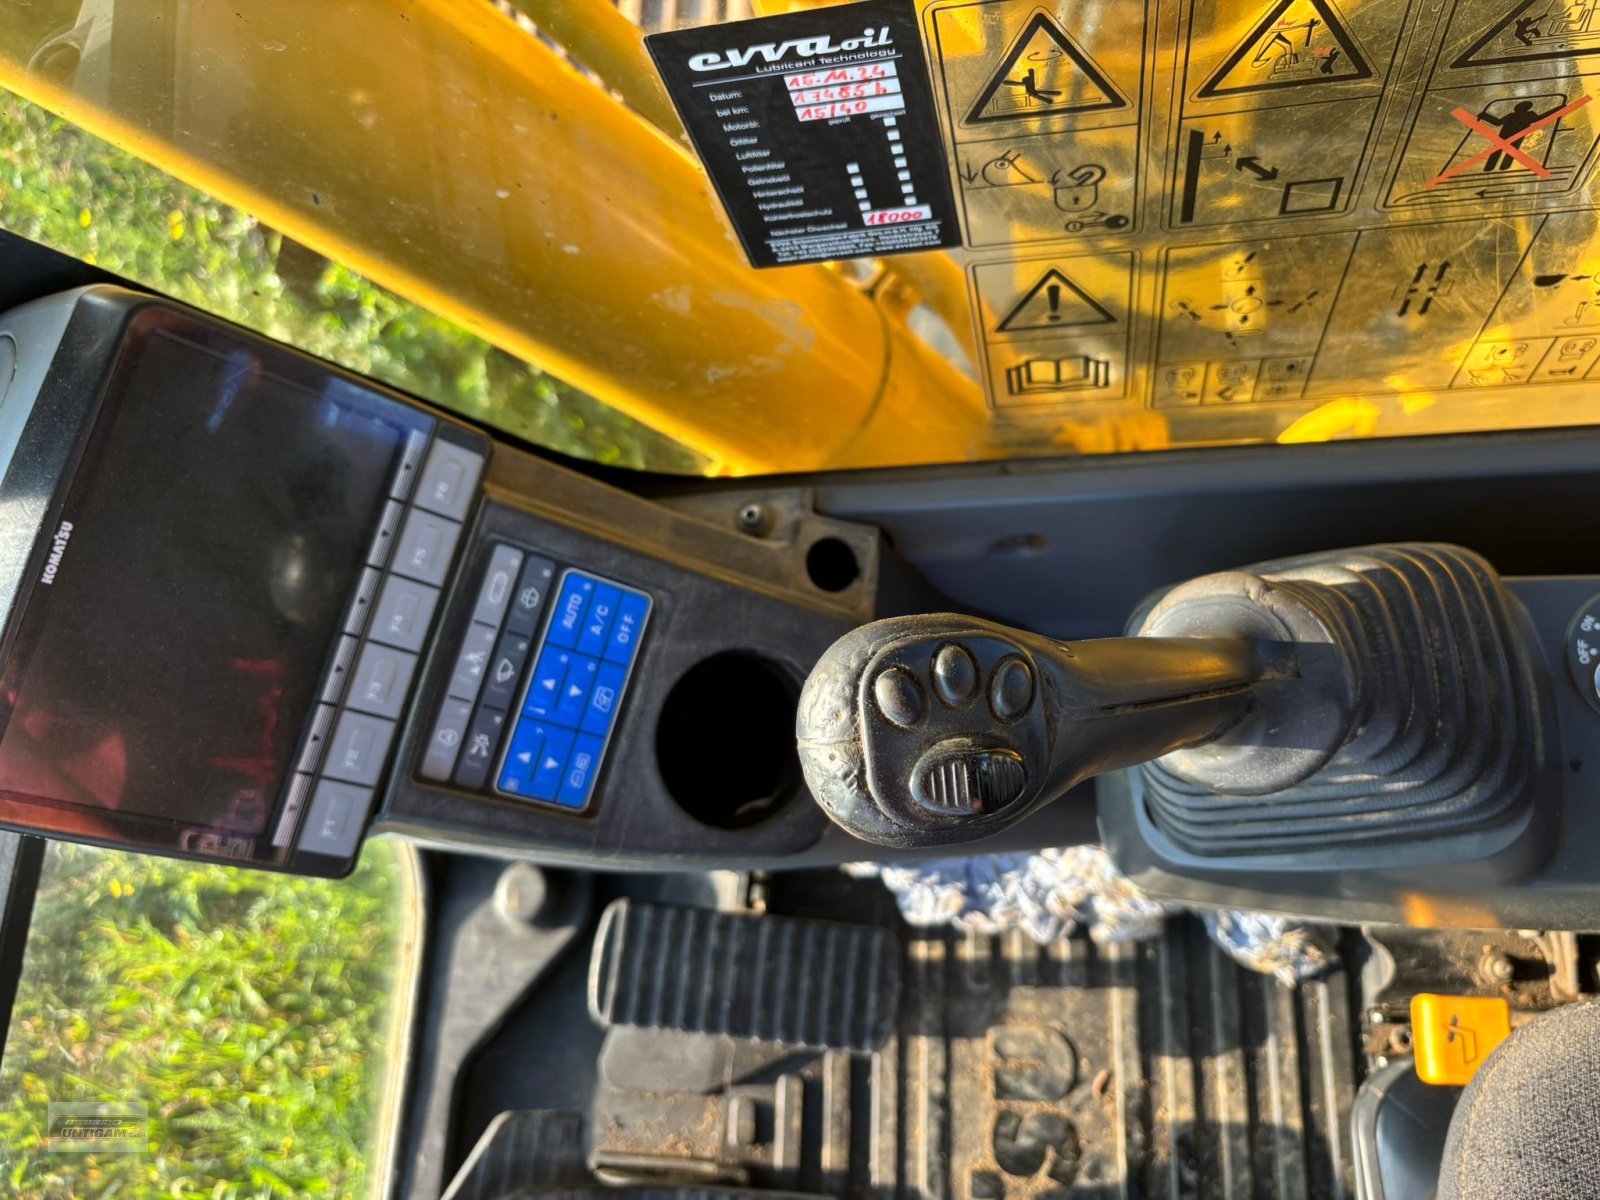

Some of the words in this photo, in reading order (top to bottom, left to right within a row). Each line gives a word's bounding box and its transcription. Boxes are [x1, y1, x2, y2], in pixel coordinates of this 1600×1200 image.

[756, 59, 816, 73] Lubricant
[818, 48, 897, 65] Technology
[709, 90, 743, 102] Datum:
[41, 521, 73, 585] KOMATSU
[562, 594, 582, 629] AUTO
[590, 604, 609, 636] A/C
[1580, 614, 1596, 632] ON
[617, 614, 635, 644] OFF
[1577, 639, 1590, 664] OFF
